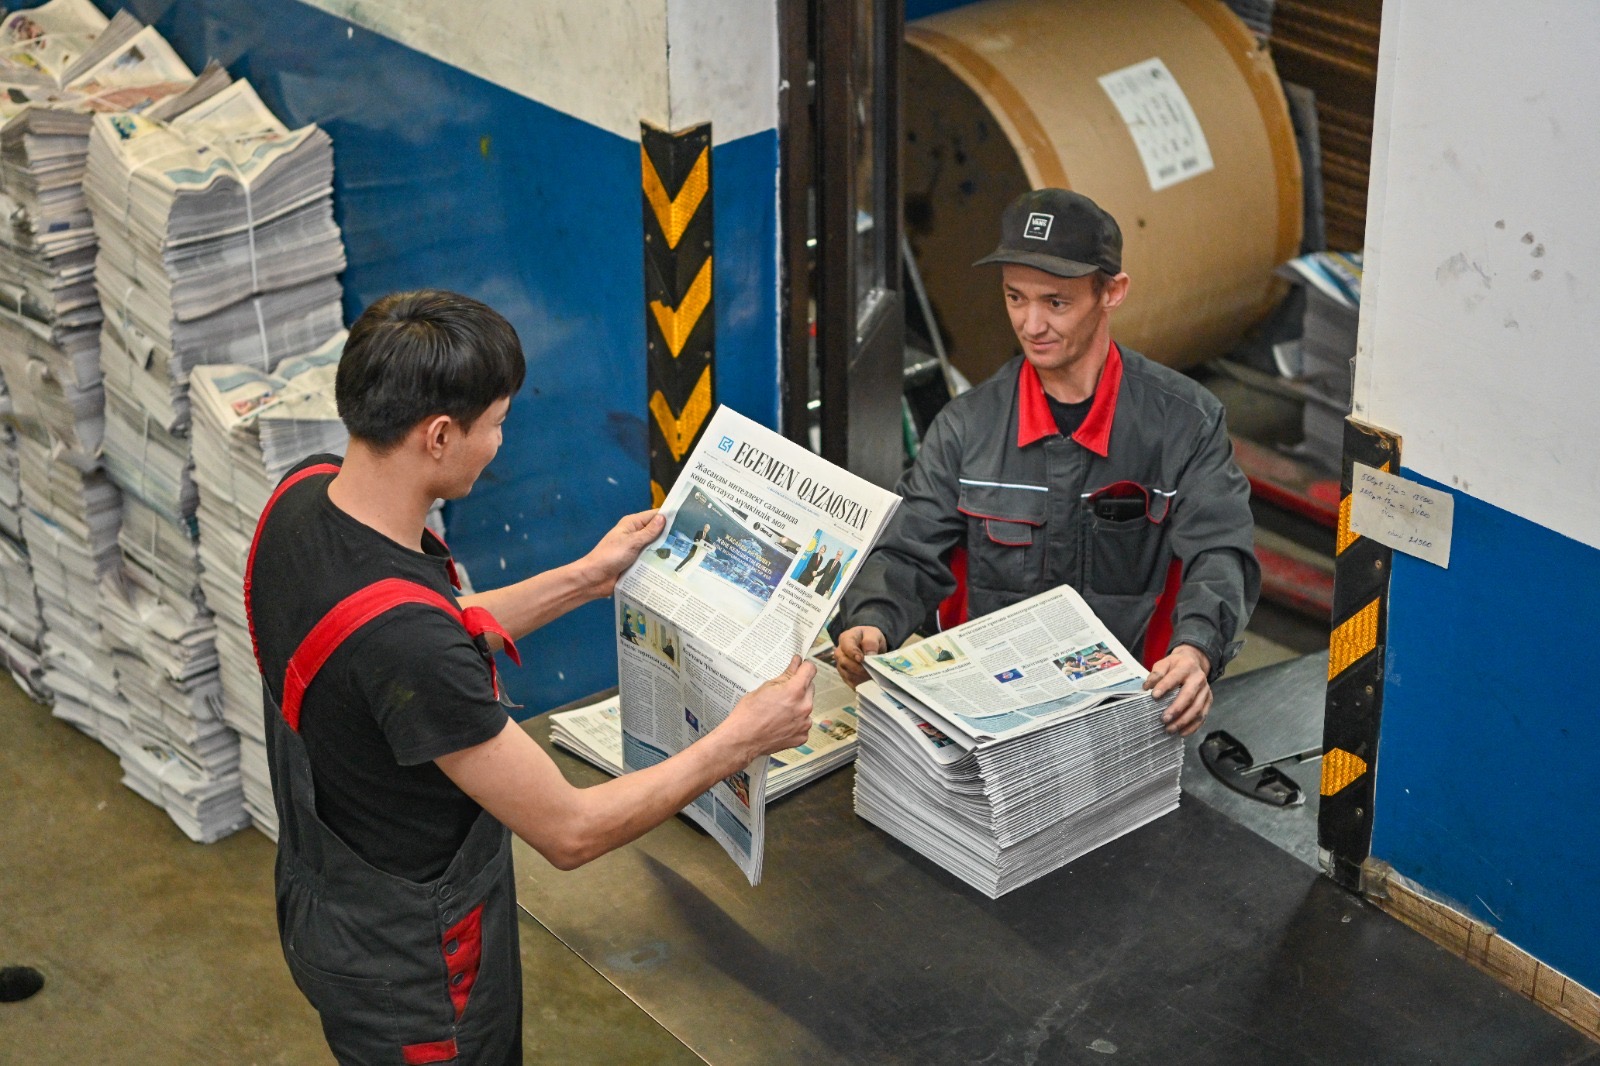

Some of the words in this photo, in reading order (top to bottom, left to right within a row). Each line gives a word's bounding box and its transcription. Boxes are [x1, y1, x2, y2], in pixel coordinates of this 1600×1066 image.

[690, 472, 706, 485] көш
[706, 479, 735, 501] бастауға
[734, 497, 773, 522] мүмкіндік
[771, 518, 786, 530] мол
[695, 461, 729, 485] Жасанды
[728, 481, 764, 505] интеллект
[763, 501, 799, 526] саласында
[733, 442, 800, 491] EGEMEN
[797, 477, 872, 532] QAZAQSTAN
